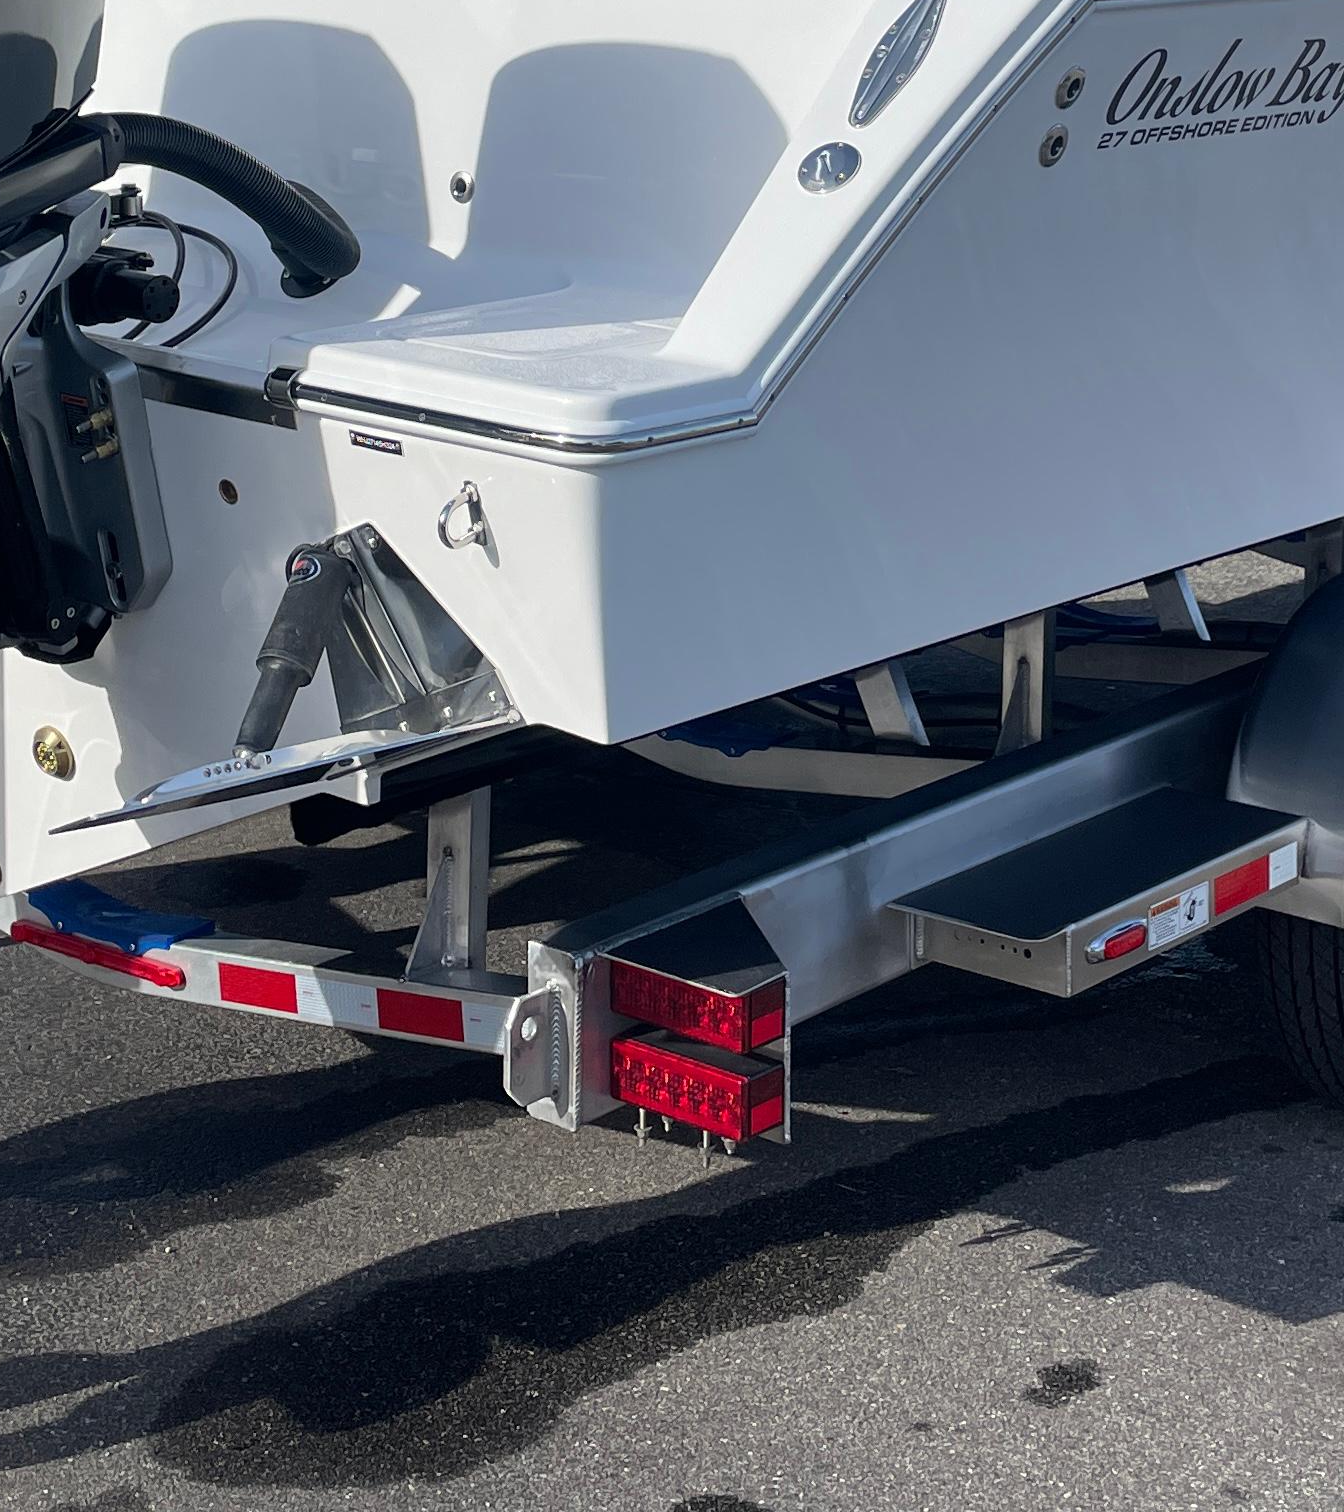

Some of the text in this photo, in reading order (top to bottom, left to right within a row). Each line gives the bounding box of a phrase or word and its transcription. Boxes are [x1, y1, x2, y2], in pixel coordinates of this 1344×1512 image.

[1106, 38, 1276, 125] Onslow
[1097, 109, 1316, 149] 27 OFFSHORE EDITION
